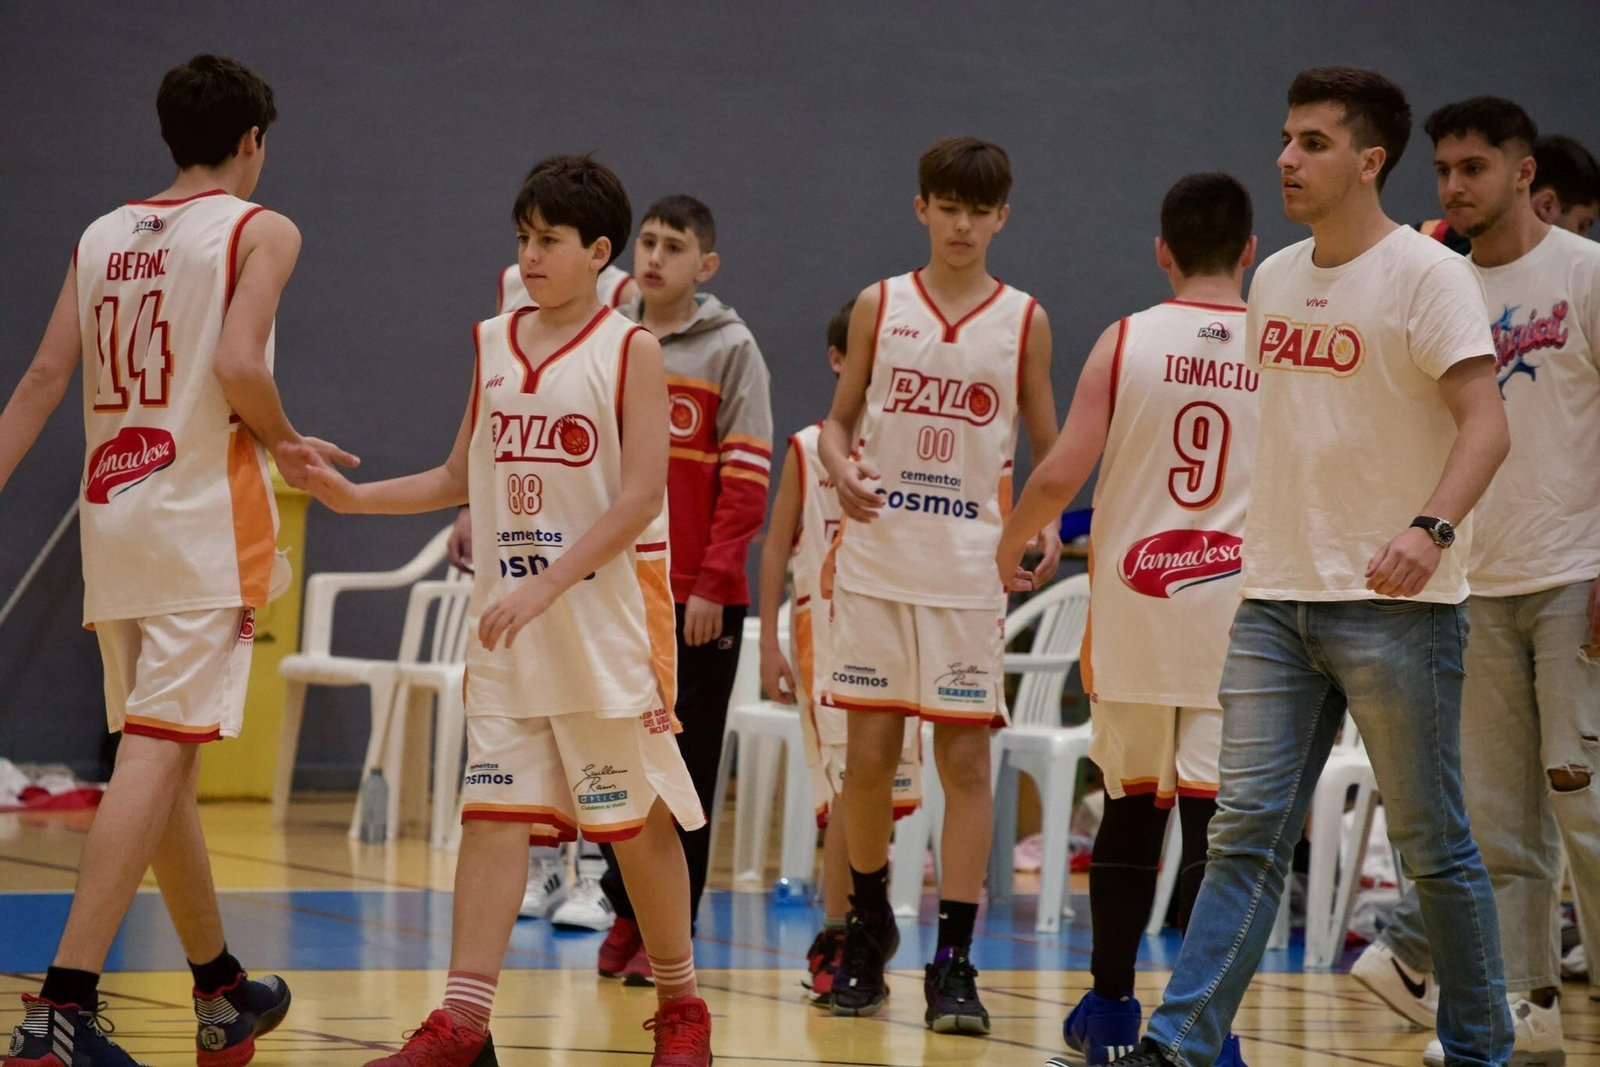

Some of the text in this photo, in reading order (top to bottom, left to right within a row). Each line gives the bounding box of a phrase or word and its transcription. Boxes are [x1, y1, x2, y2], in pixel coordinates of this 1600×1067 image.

[1305, 297, 1328, 307] vive
[93, 290, 173, 412] 14
[892, 325, 920, 339] vive
[1259, 319, 1363, 374] PALO
[882, 367, 999, 427] PALO
[917, 425, 955, 463] 00
[1168, 401, 1231, 510] 9
[507, 473, 543, 515] 88
[832, 671, 889, 688] cosmos
